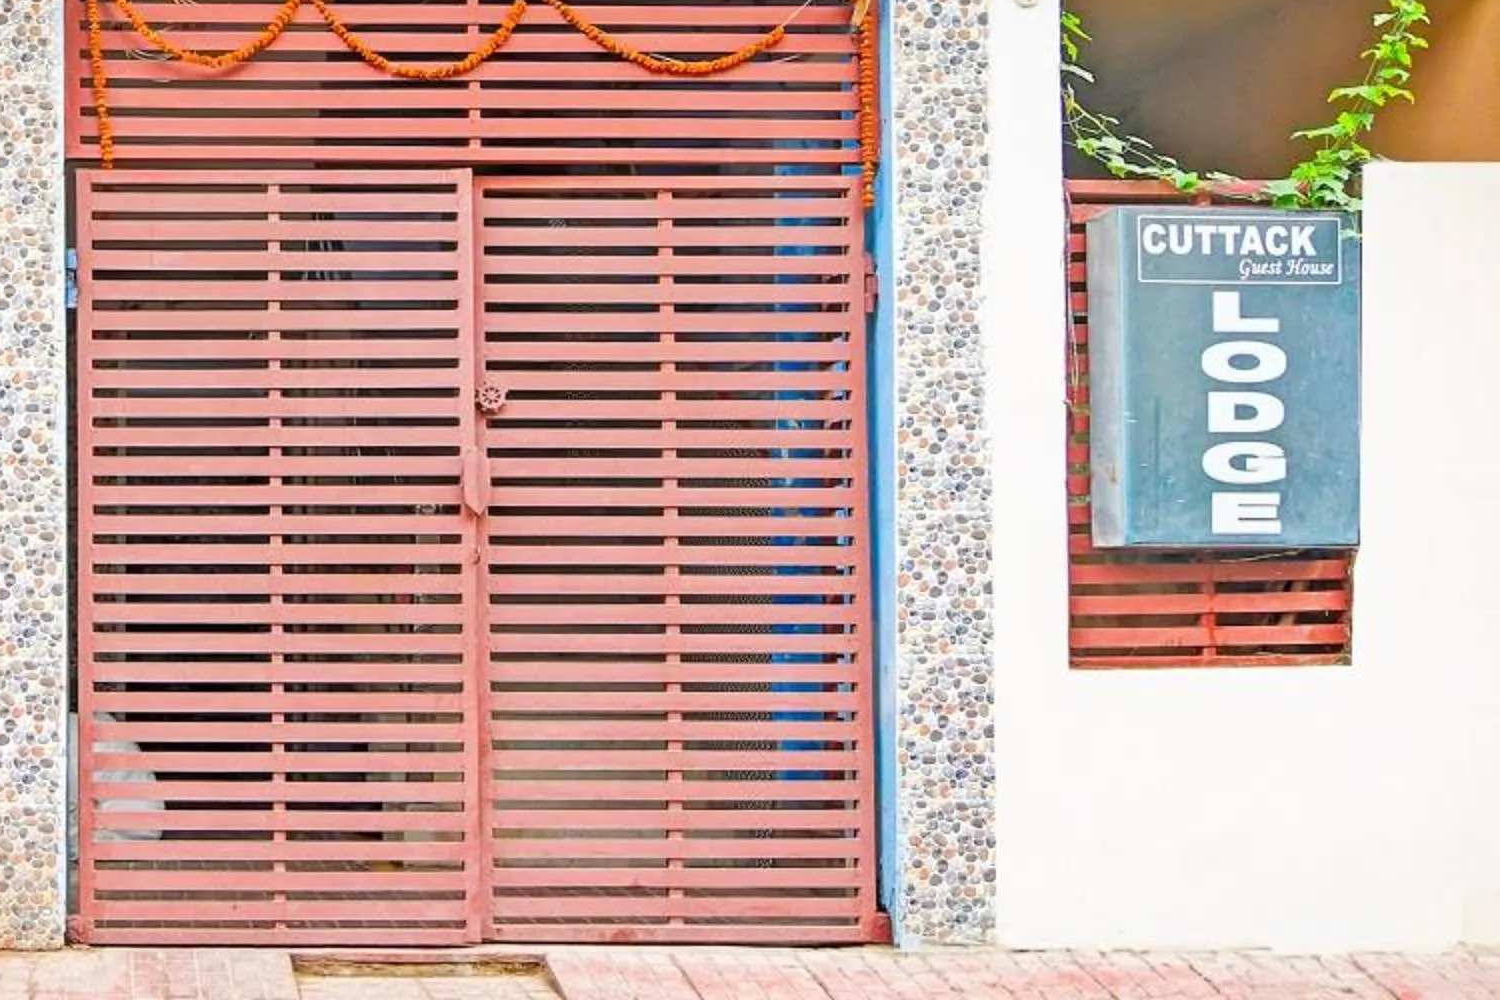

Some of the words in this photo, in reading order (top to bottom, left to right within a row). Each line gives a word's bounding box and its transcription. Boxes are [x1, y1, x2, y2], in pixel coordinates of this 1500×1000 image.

[1142, 223, 1316, 256] CUTTACK
[1238, 258, 1283, 280] Guest
[1285, 258, 1335, 277] House
[1201, 291, 1288, 534] LODGE
